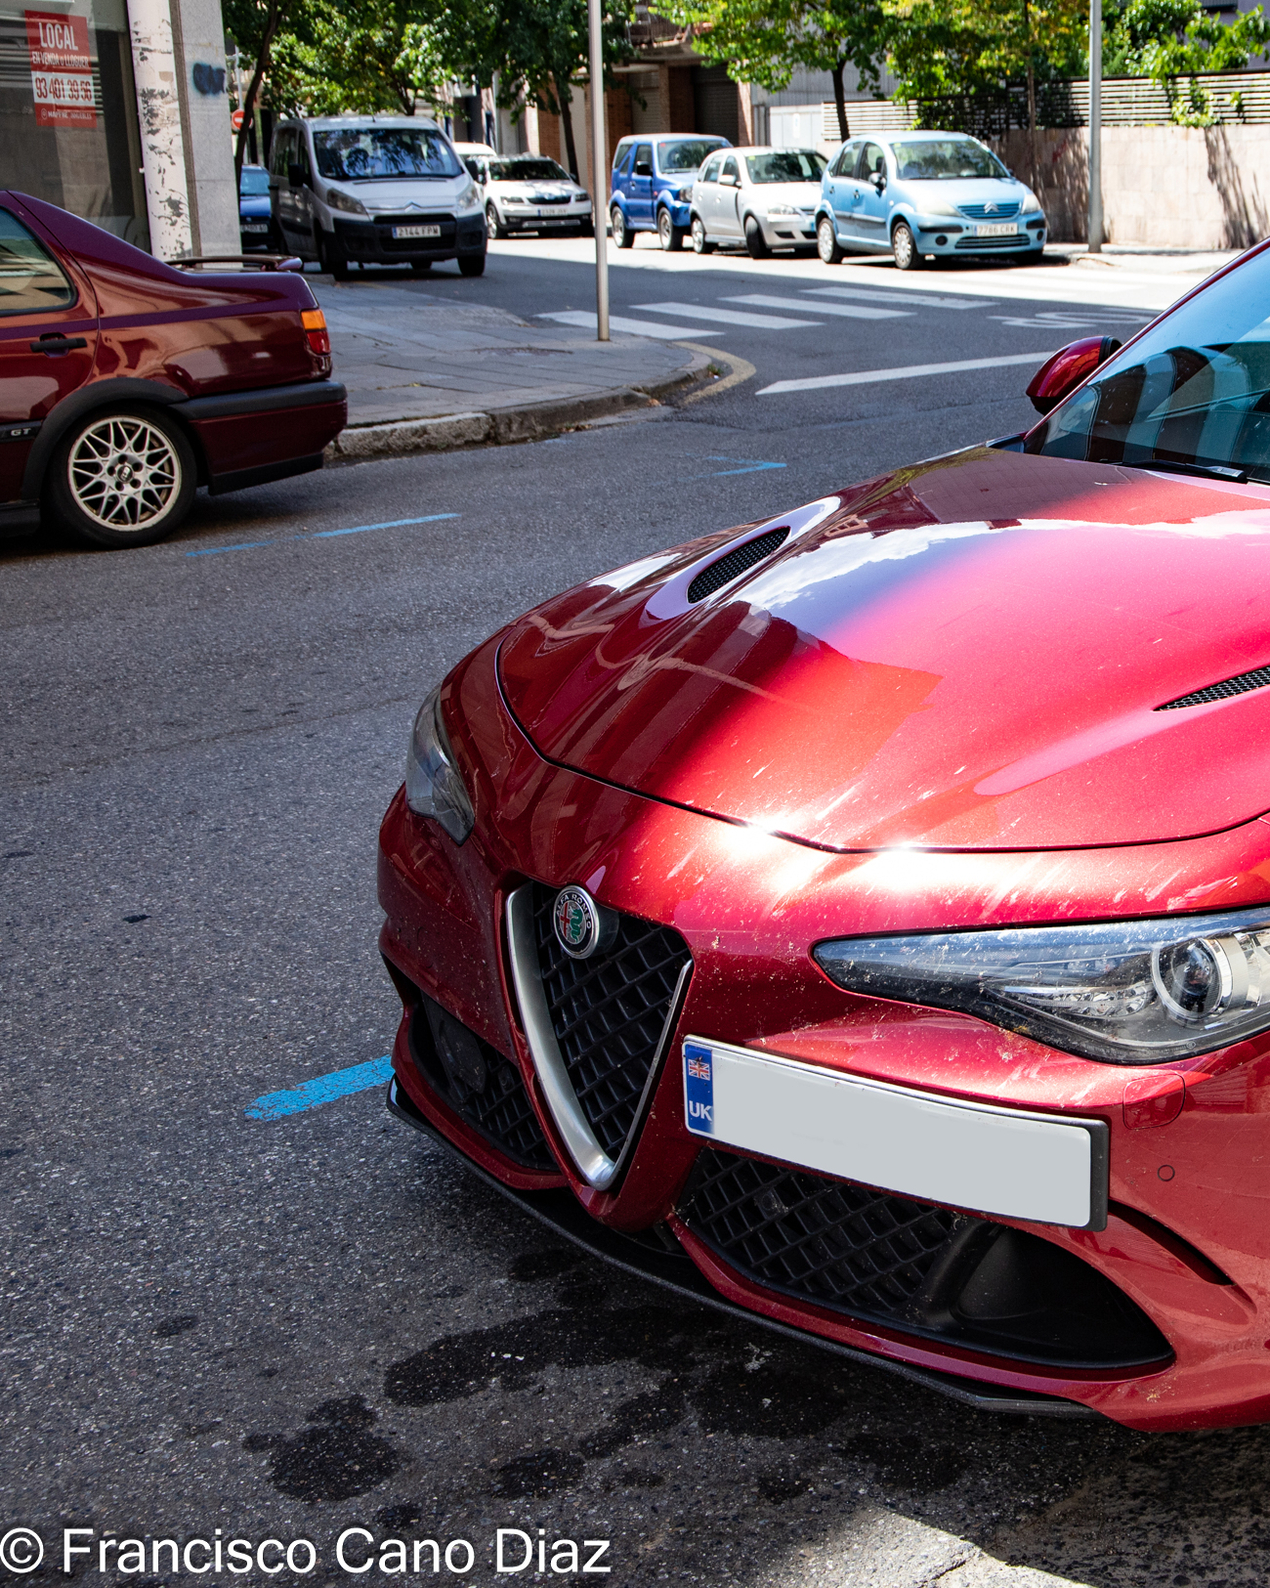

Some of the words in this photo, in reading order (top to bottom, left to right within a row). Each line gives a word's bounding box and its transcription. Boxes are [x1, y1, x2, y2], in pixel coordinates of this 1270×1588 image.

[38, 22, 79, 51] LOCAL
[32, 51, 41, 63] EN
[41, 53, 60, 66] VENDA
[65, 56, 89, 68] LLOGUER
[35, 77, 48, 99] 93
[49, 78, 66, 99] 401
[67, 79, 80, 100] 39
[80, 81, 92, 102] 56
[10, 428, 31, 436] GT
[556, 894, 570, 917] ALFA
[571, 894, 592, 929] ROMEO
[688, 1100, 713, 1122] UK
